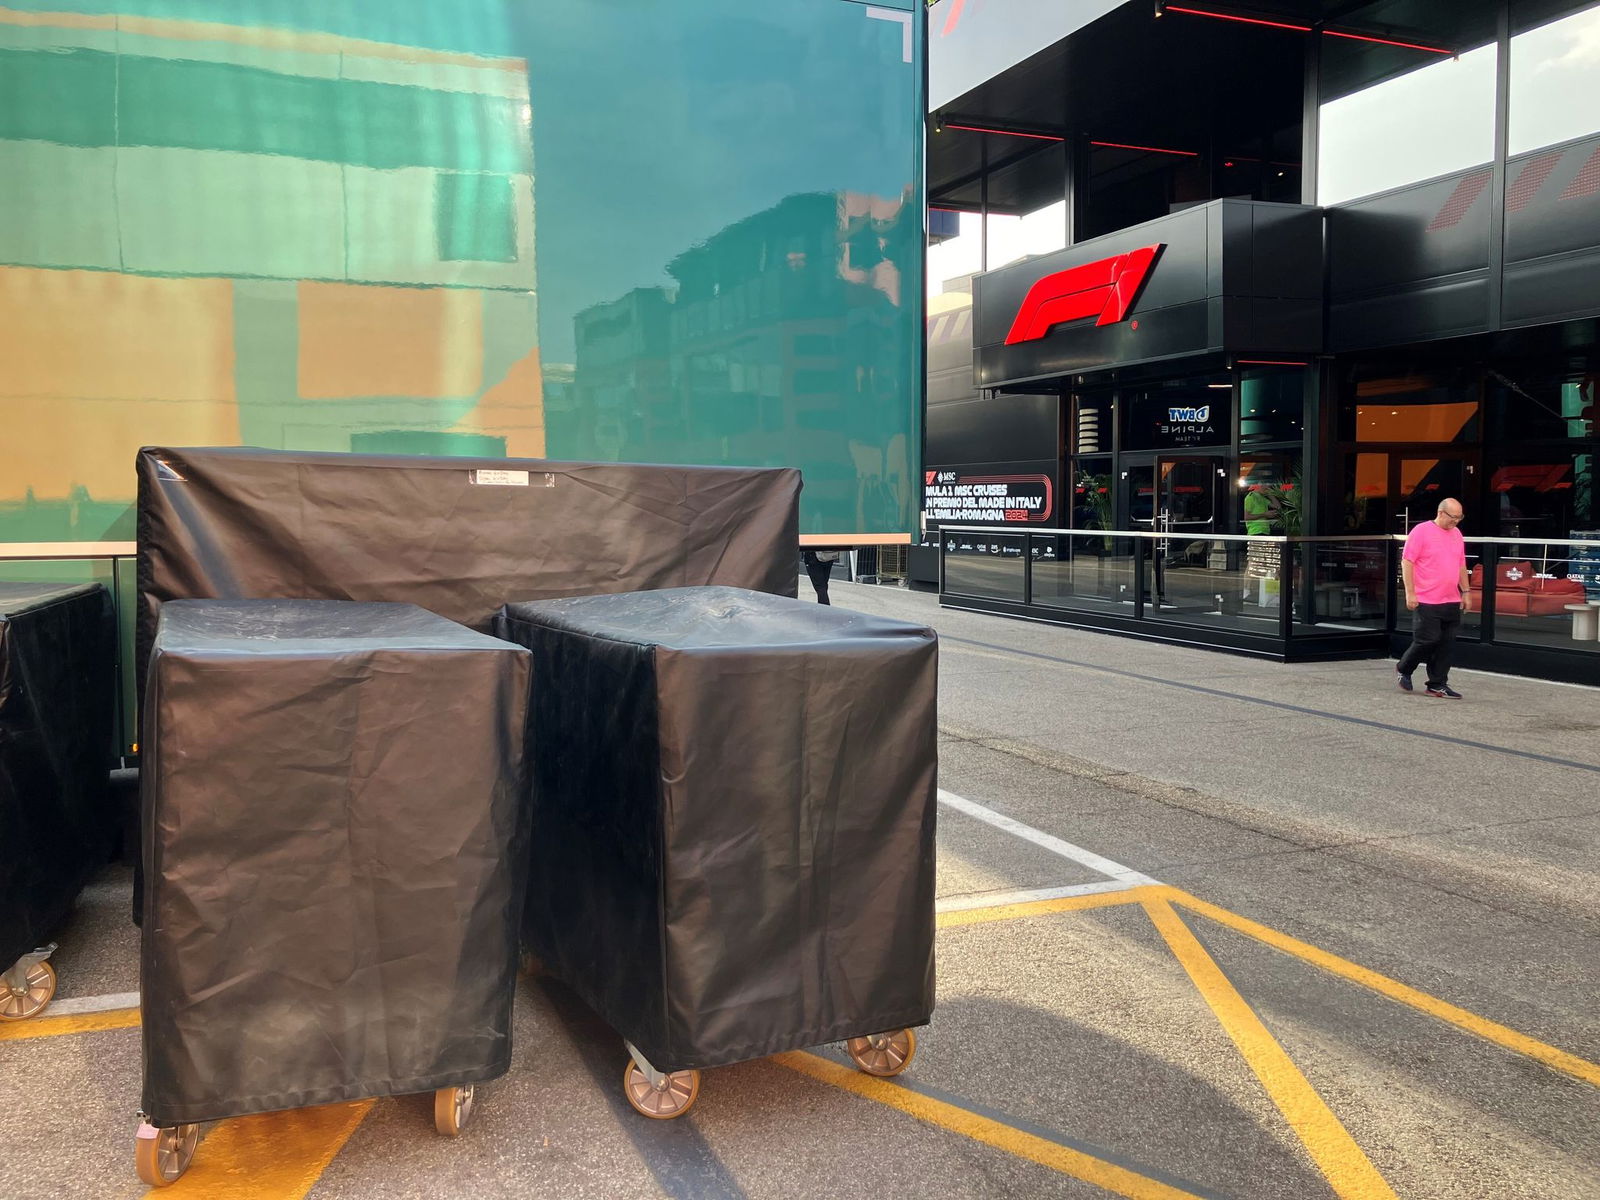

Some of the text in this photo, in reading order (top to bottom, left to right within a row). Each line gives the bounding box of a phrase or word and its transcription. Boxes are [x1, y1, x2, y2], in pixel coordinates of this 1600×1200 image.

[1004, 243, 1165, 346] F1
[943, 472, 956, 481] MSC
[948, 486, 953, 497] 1
[954, 486, 973, 497] MSC
[973, 484, 1008, 497] CRUISES
[933, 497, 962, 508] PREMIO
[962, 497, 978, 508] DEL
[978, 497, 1005, 508] MADE
[1005, 497, 1016, 508] IN
[1016, 496, 1042, 509] ITALY
[1005, 510, 1028, 520] 2024
